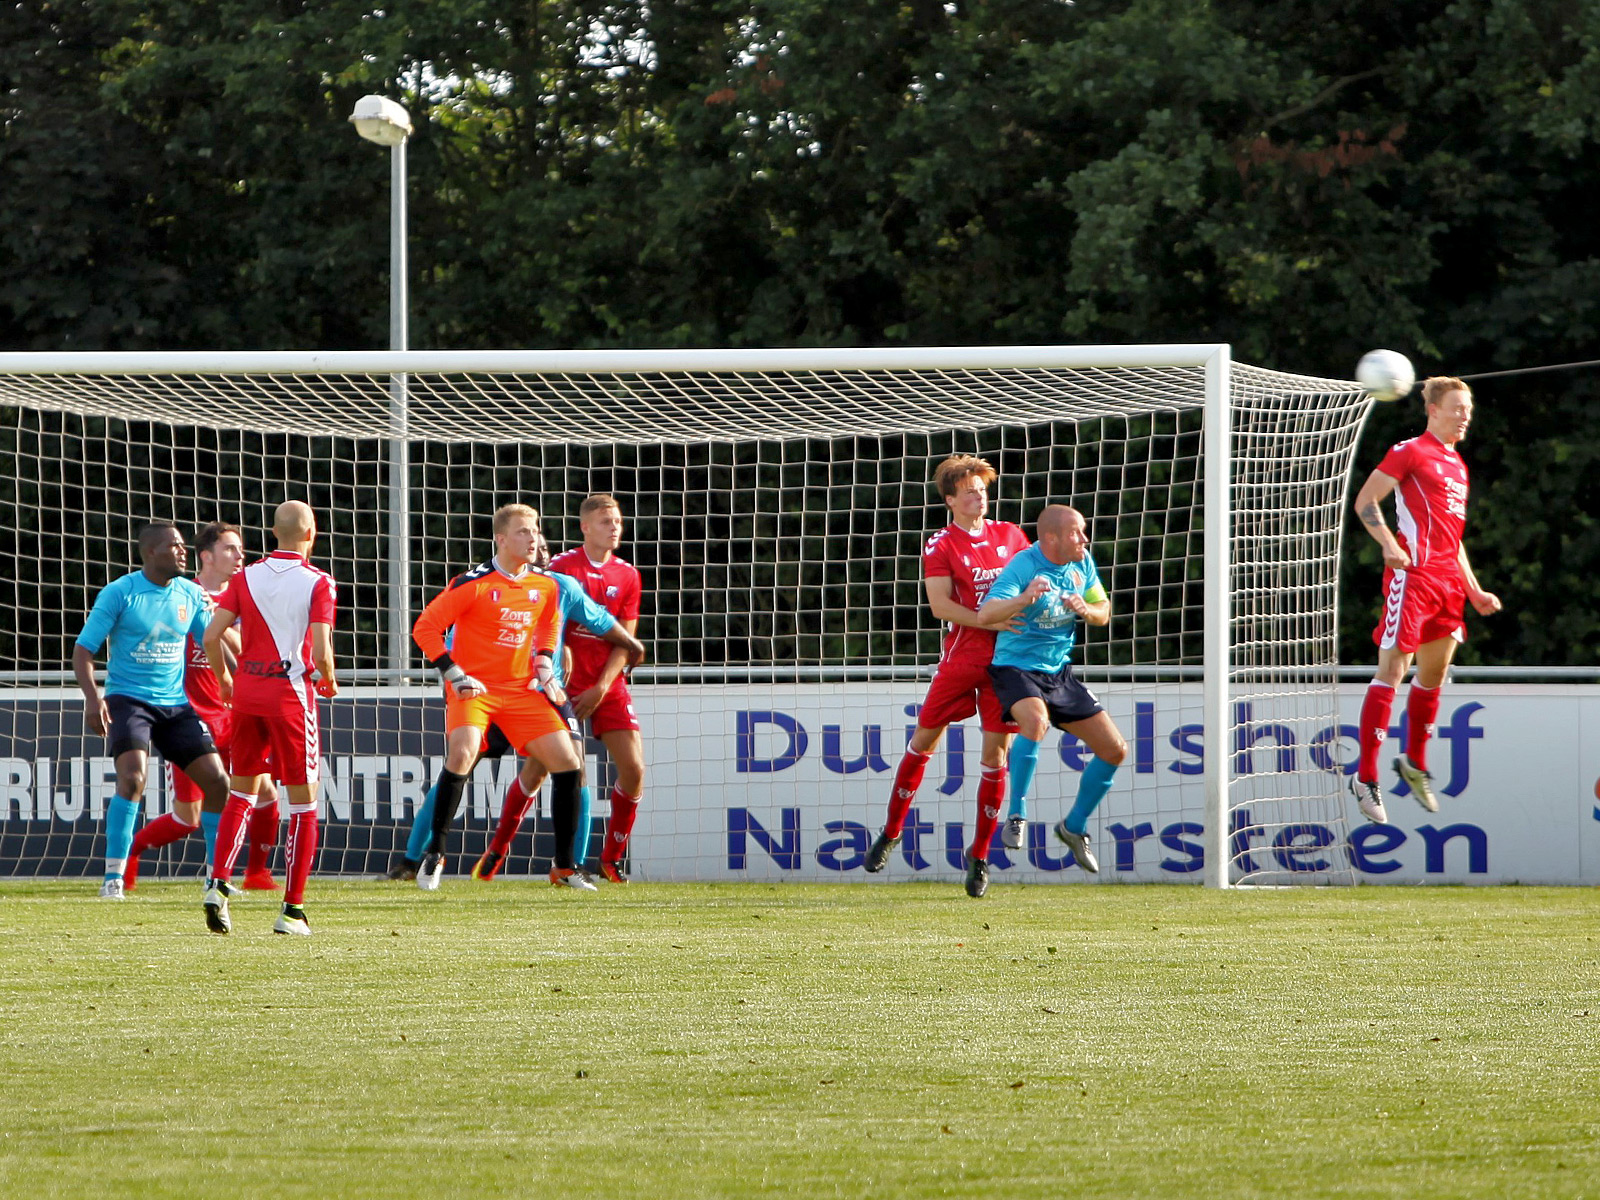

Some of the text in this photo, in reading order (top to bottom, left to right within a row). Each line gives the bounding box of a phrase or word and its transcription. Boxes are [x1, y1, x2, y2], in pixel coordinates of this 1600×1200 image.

[499, 607, 532, 625] Zorg
[736, 701, 1485, 797] Dujelshof
[727, 808, 1488, 874] Natuursteen
